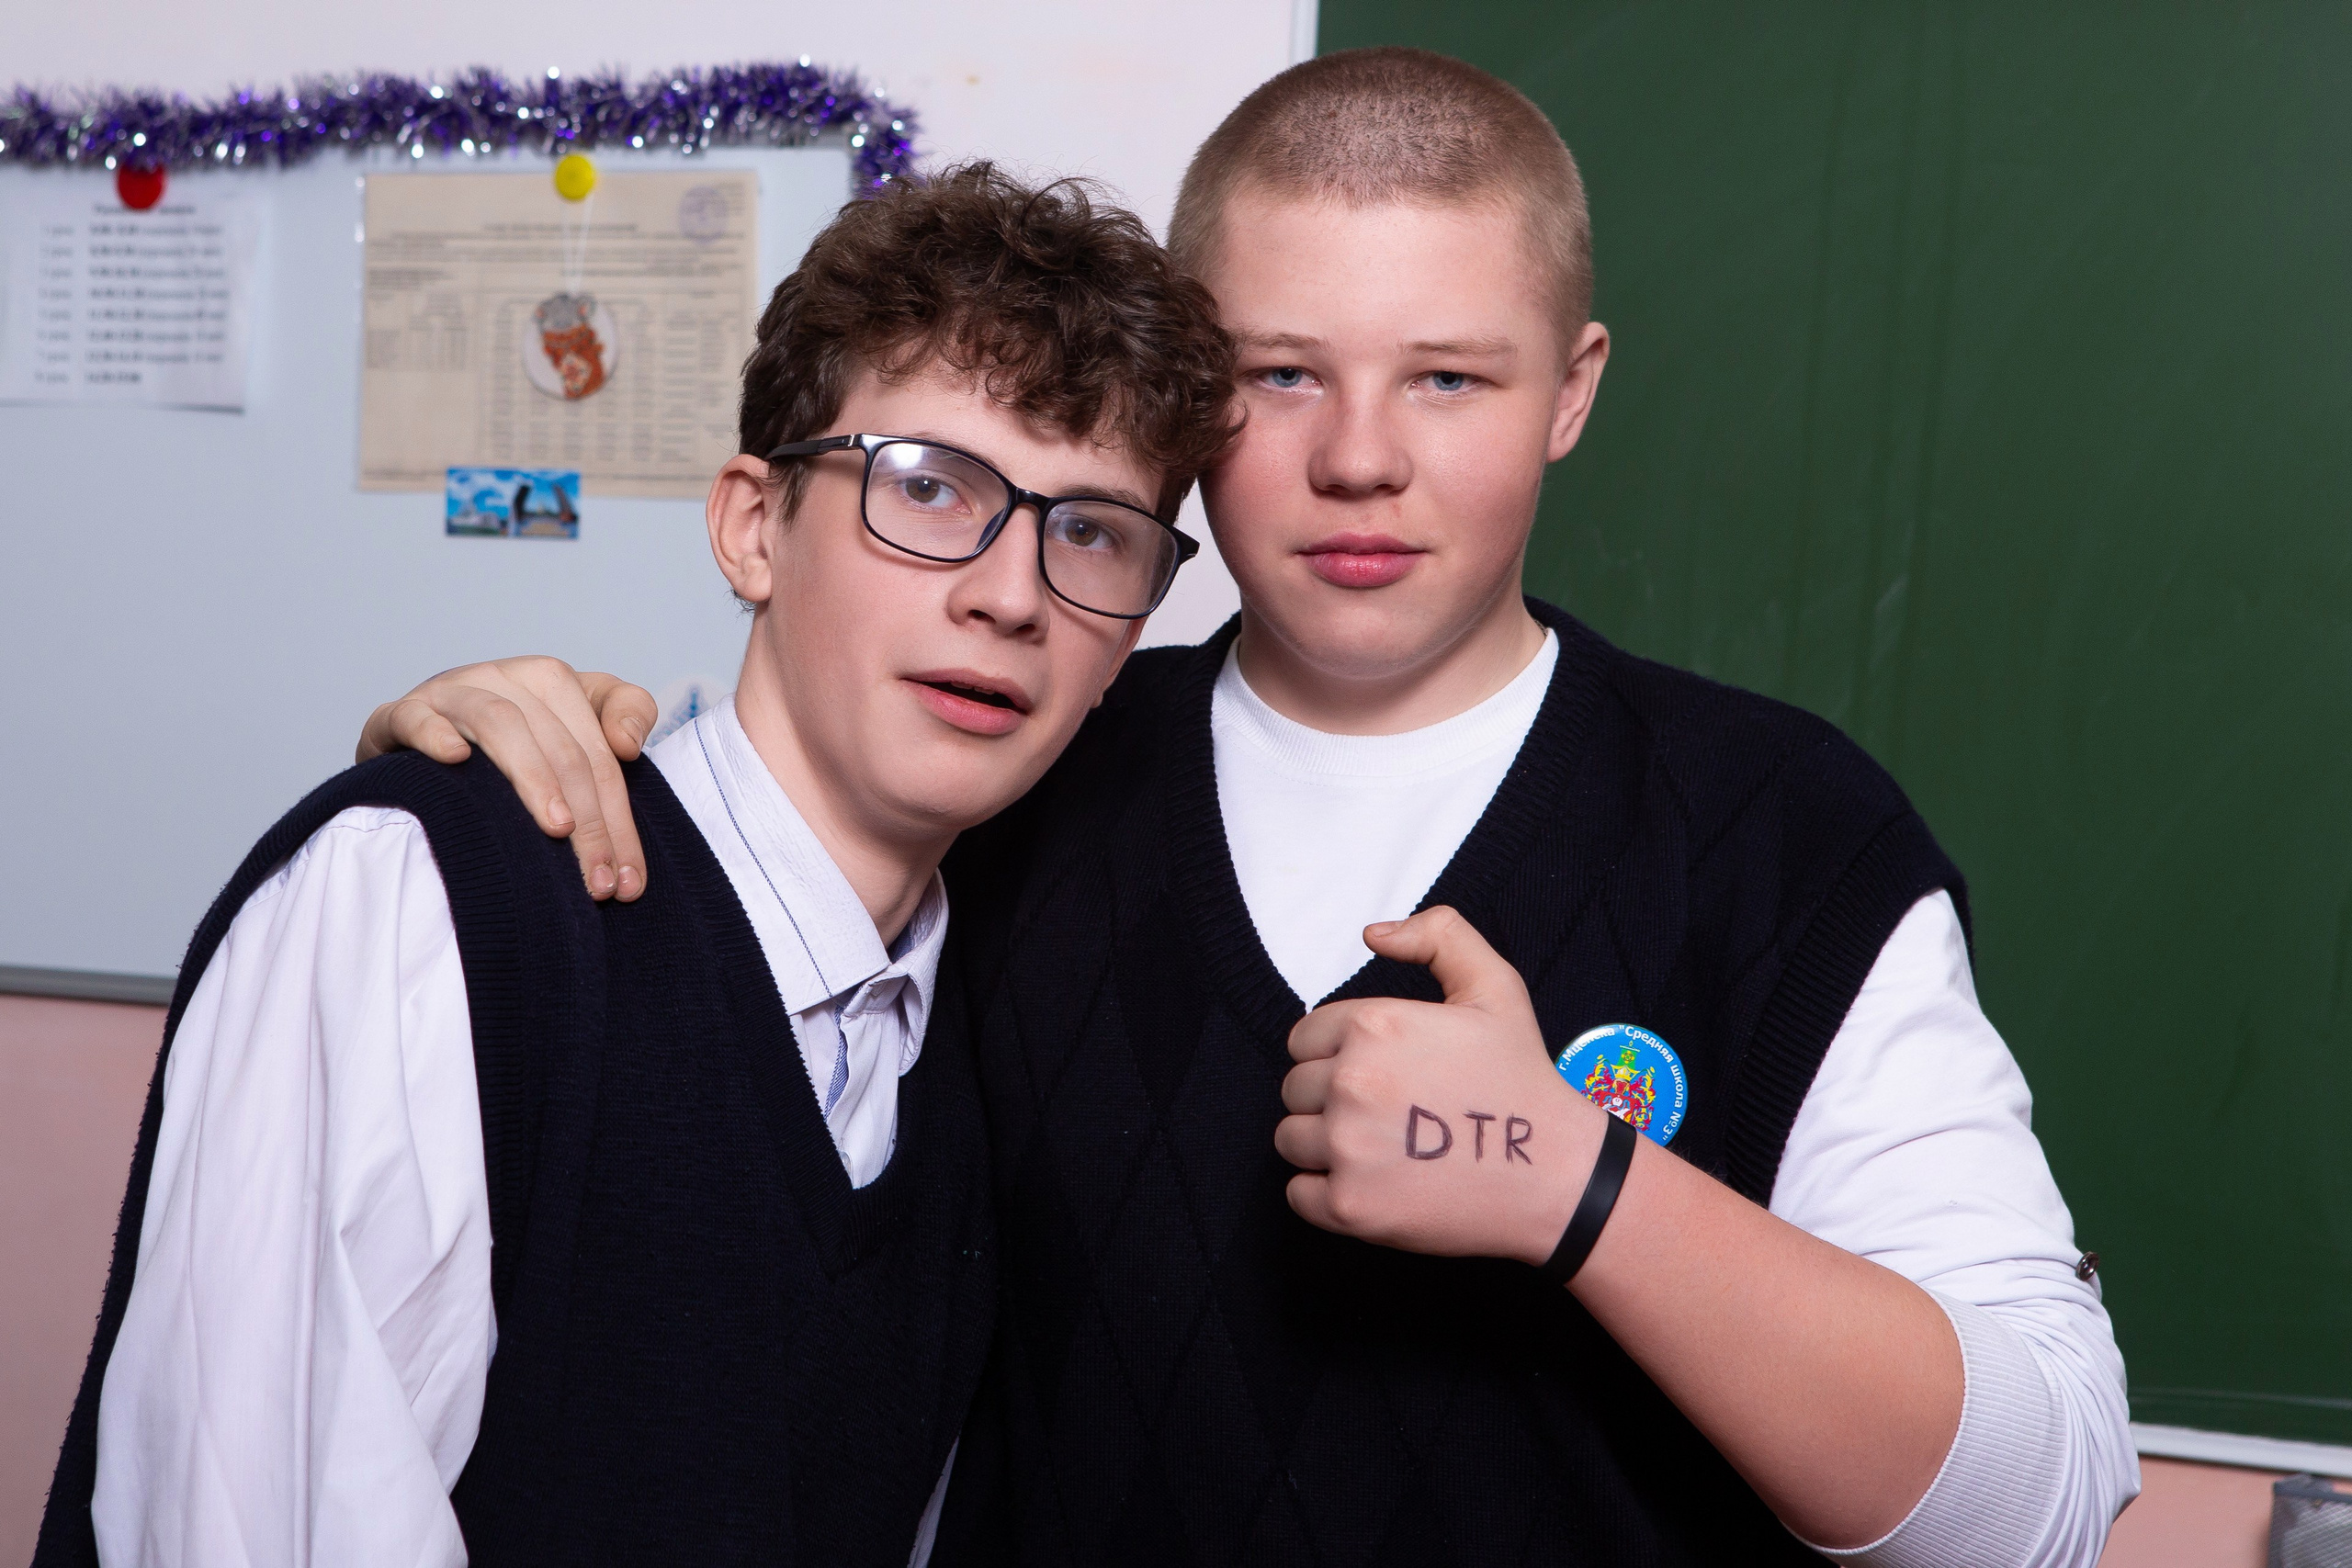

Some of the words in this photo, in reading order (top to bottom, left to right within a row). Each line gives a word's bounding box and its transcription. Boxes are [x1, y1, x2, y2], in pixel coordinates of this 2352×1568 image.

[1619, 1025, 1674, 1064] "Средняя
[1670, 1064, 1684, 1108] школа
[1405, 1103, 1533, 1166] DTR
